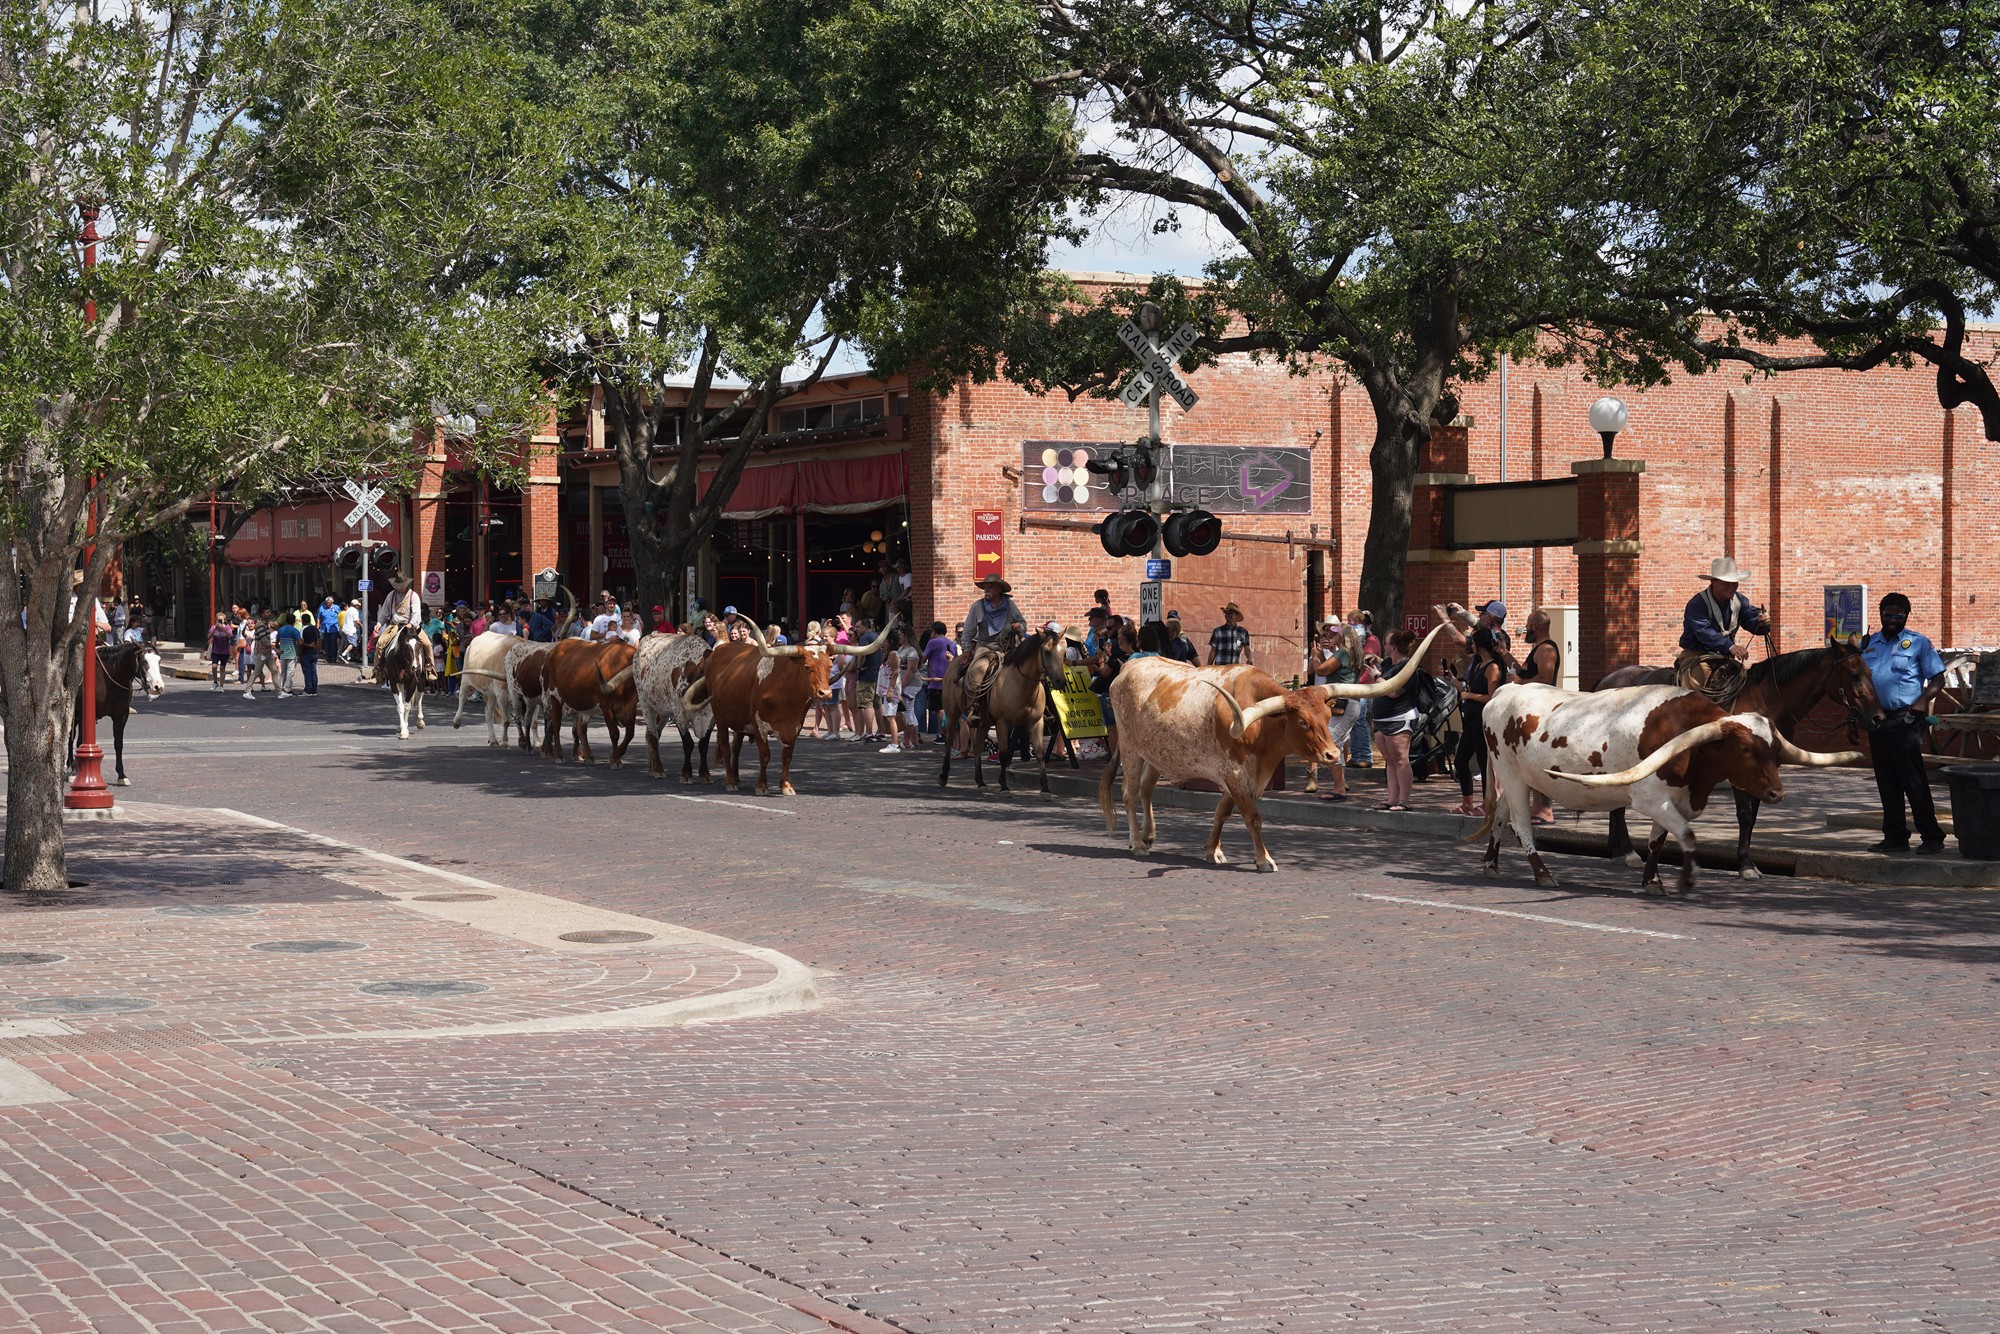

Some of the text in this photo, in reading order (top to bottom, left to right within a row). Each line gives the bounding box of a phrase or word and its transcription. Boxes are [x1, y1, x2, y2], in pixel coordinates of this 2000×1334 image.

[1121, 324, 1150, 360] RAIL
[1126, 329, 1193, 402] CROSSING
[1163, 371, 1195, 407] ROAD
[346, 482, 361, 501] RAIL
[348, 487, 383, 524] CROSSIN
[369, 506, 388, 525] ROAD
[1142, 588, 1158, 600] ONE
[1142, 603, 1158, 615] WAY
[1407, 617, 1426, 630] FDC
[1066, 709, 1096, 718] NOW OPEN
[1071, 720, 1088, 728] MULE
